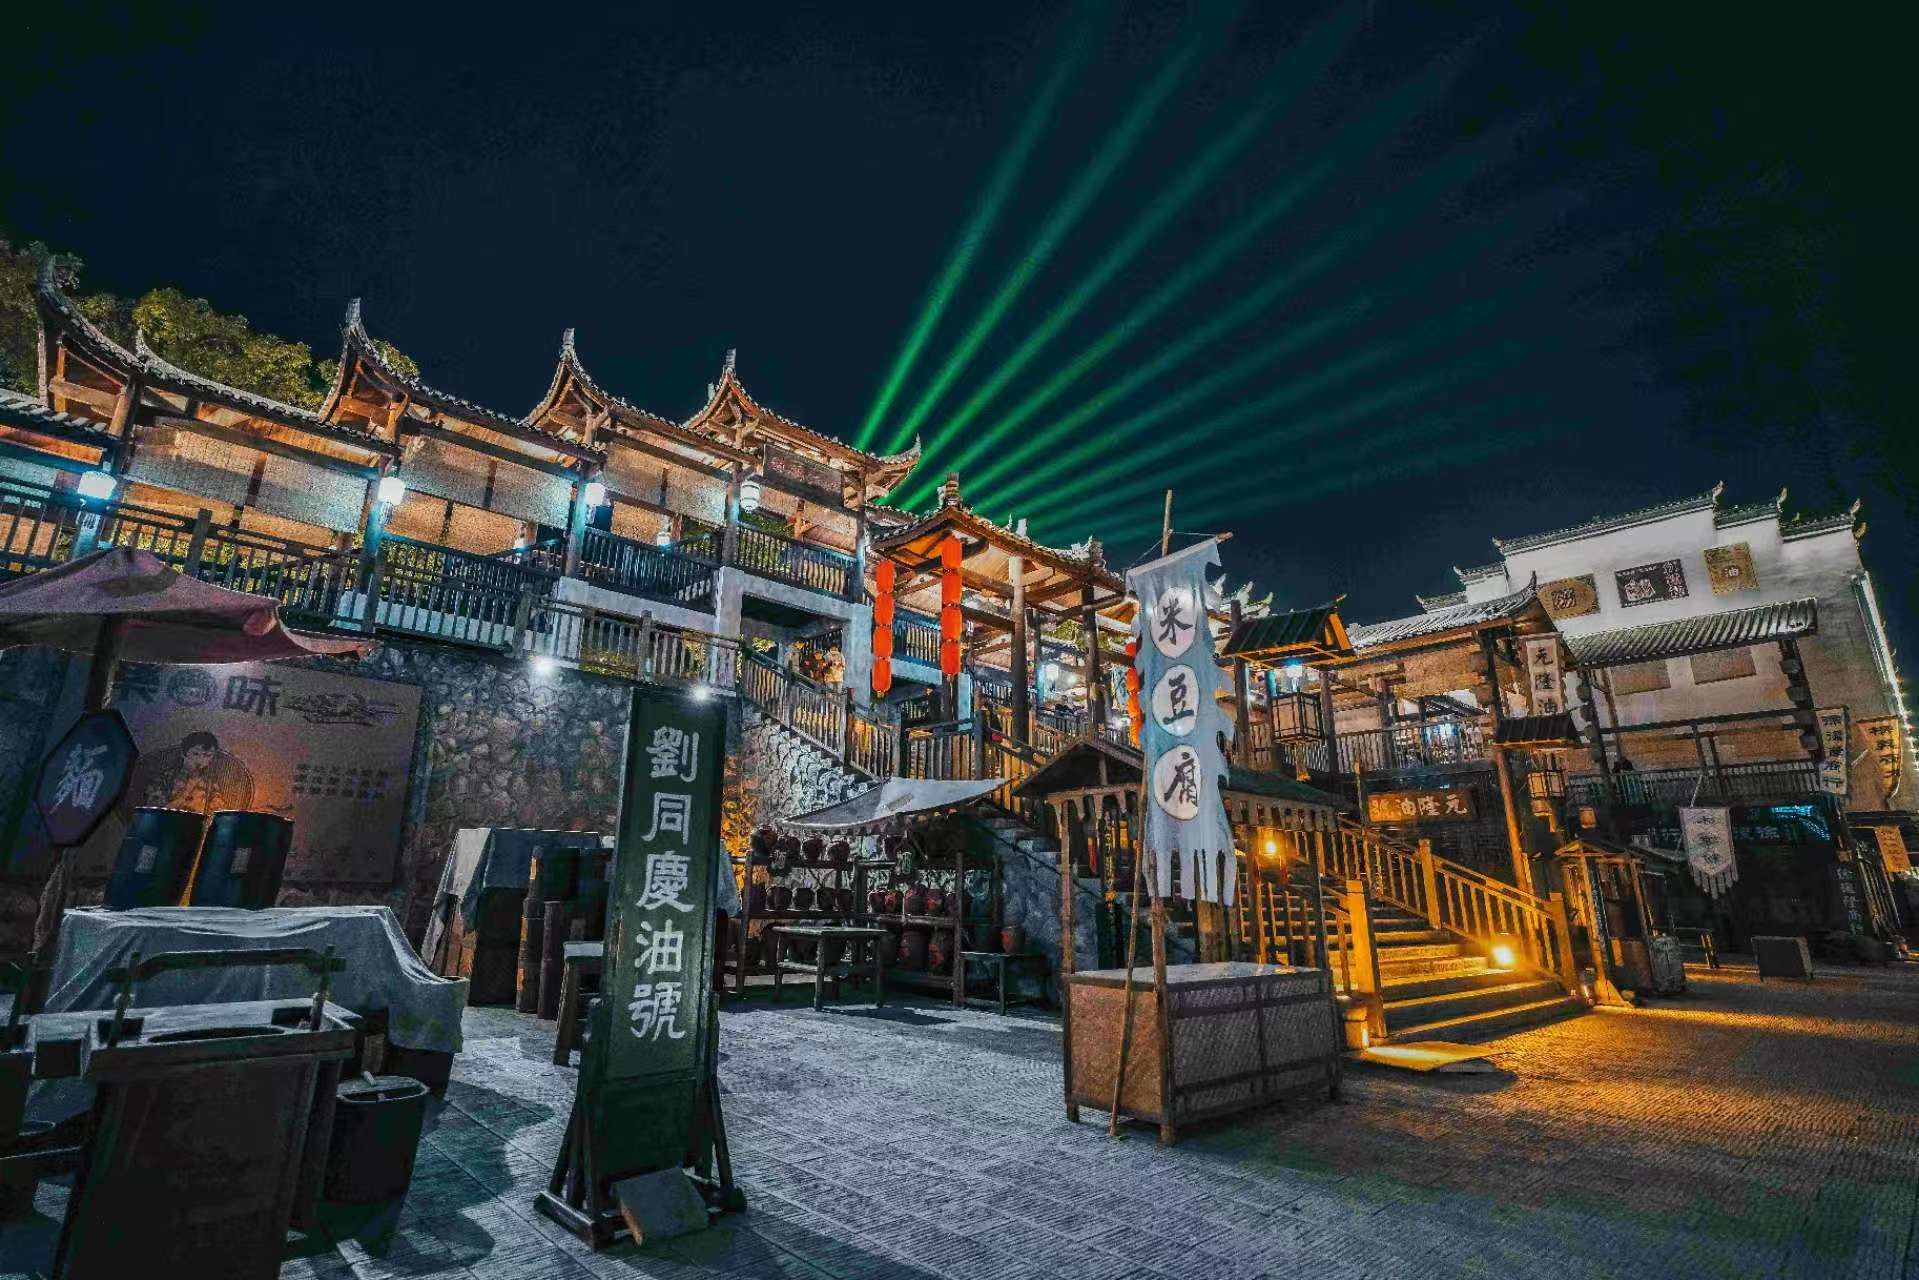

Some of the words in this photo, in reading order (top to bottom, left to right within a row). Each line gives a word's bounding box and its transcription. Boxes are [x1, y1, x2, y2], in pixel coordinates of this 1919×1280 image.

[1725, 567, 1739, 577] 油
[1158, 598, 1198, 807] 米豆腐
[1533, 647, 1558, 714] 元隆油
[628, 725, 700, 1042] 劉同慶油號
